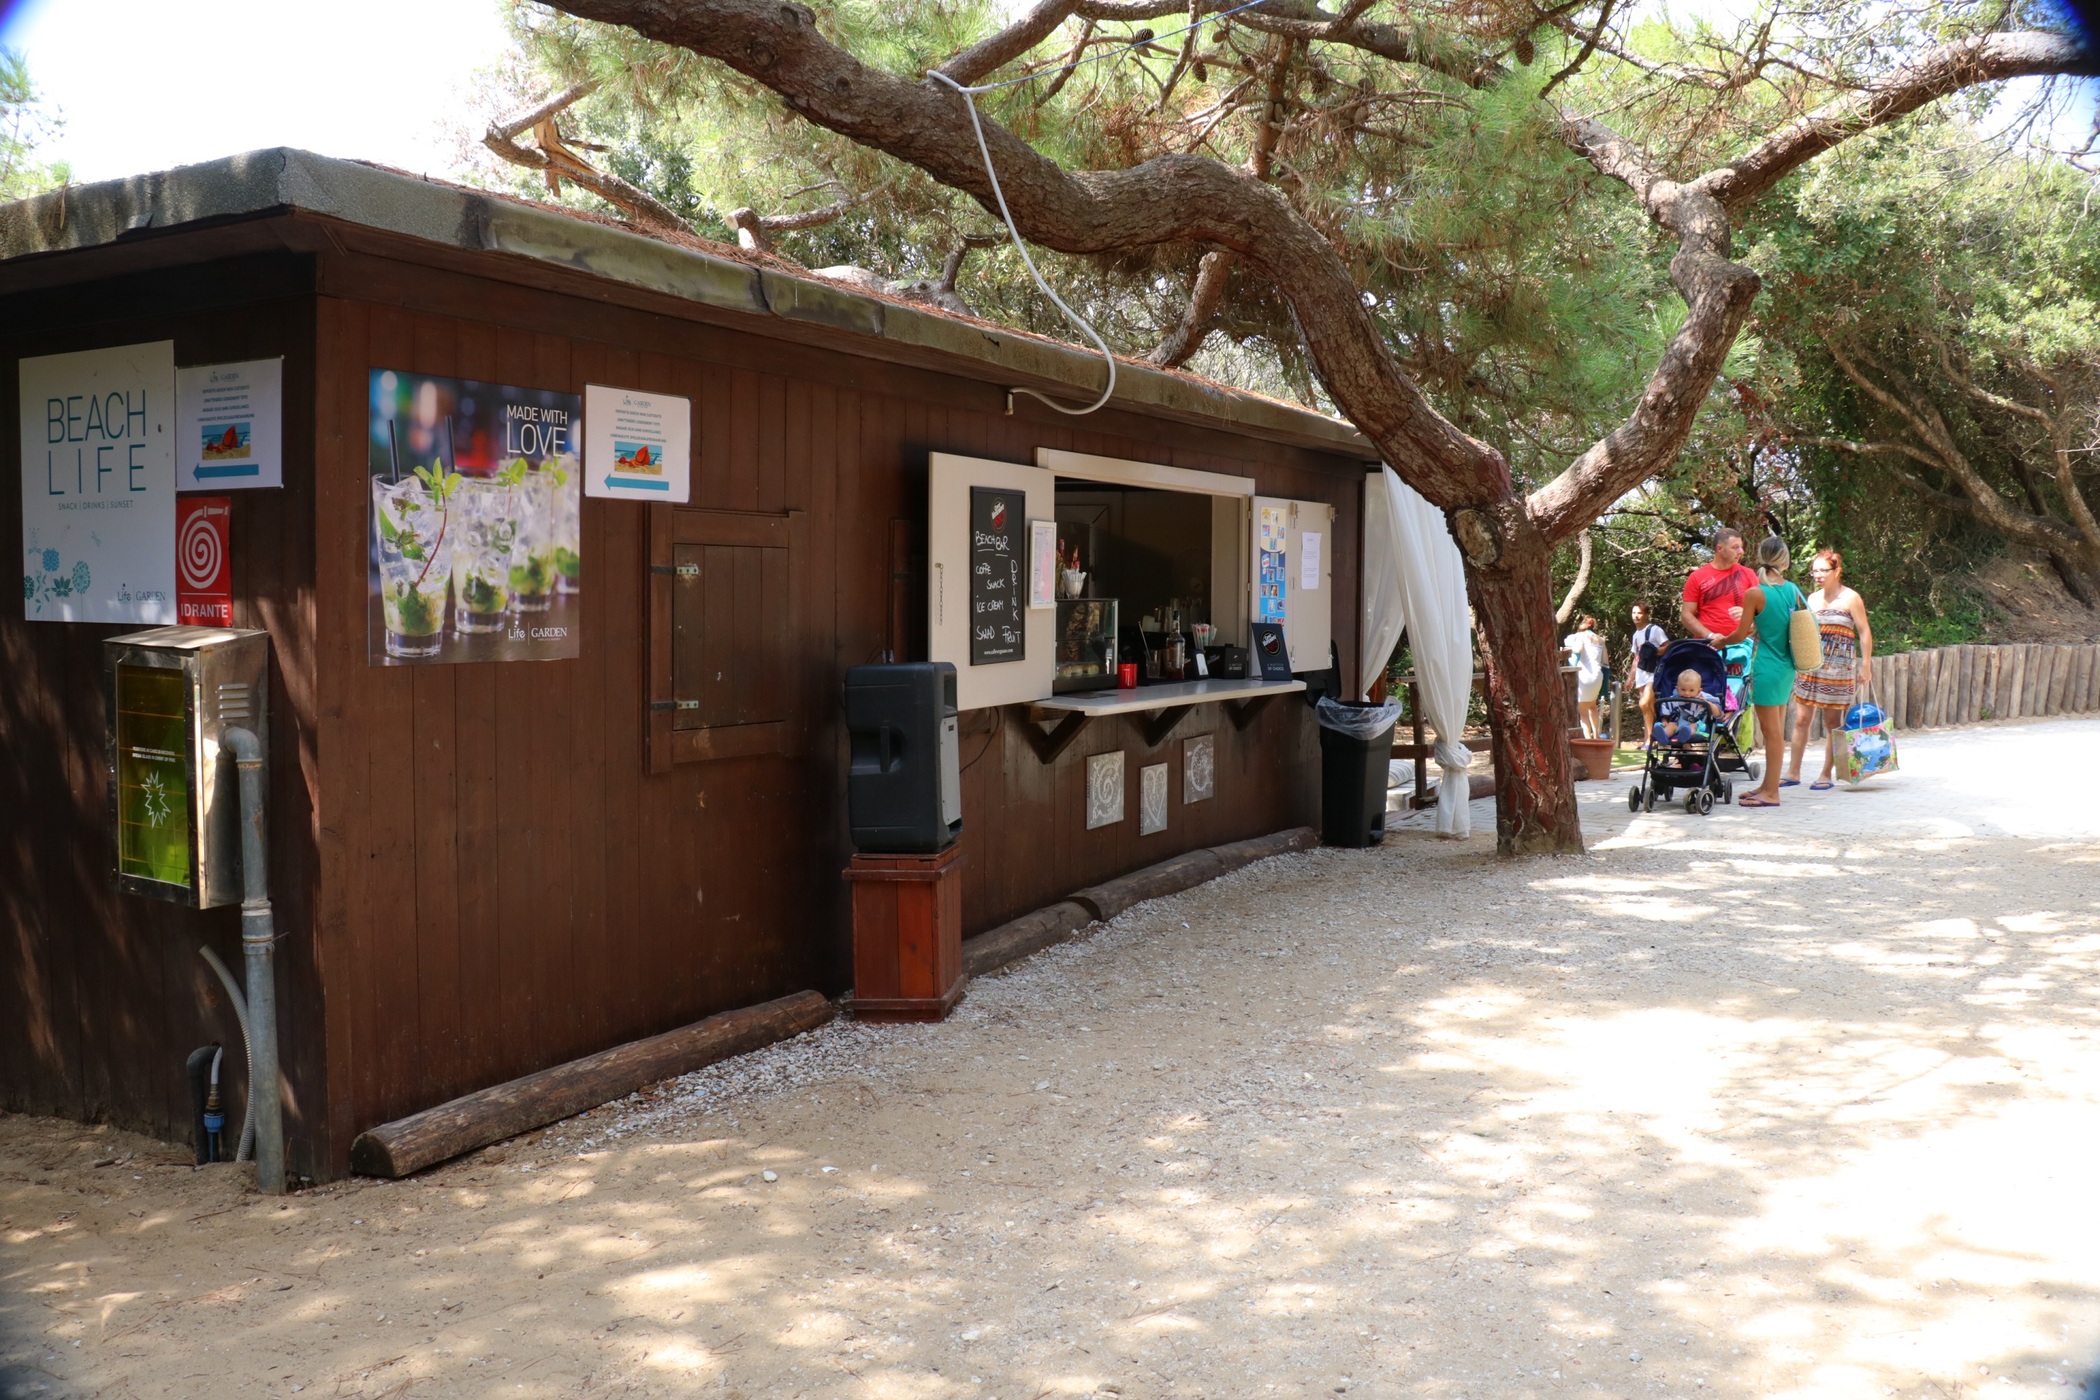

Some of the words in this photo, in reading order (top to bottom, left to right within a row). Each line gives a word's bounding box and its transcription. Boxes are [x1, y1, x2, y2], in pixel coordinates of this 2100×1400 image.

[48, 389, 146, 443] BEACH
[506, 404, 539, 422] MADE
[540, 408, 568, 425] WITH
[506, 421, 567, 458] LOVE
[49, 444, 146, 495] LIFE
[58, 502, 77, 511] SNACK
[82, 501, 105, 510] DRINKS
[110, 500, 133, 509] SUNSET
[976, 530, 996, 546] BEACH
[996, 536, 1010, 551] BAR
[117, 587, 131, 601] Life
[136, 591, 166, 601] GARDEN
[986, 578, 1006, 590] SNACK
[1010, 559, 1020, 621] DRINK
[180, 603, 229, 618] IDRANTE
[508, 626, 526, 639] Life
[531, 627, 568, 638] GARDEN
